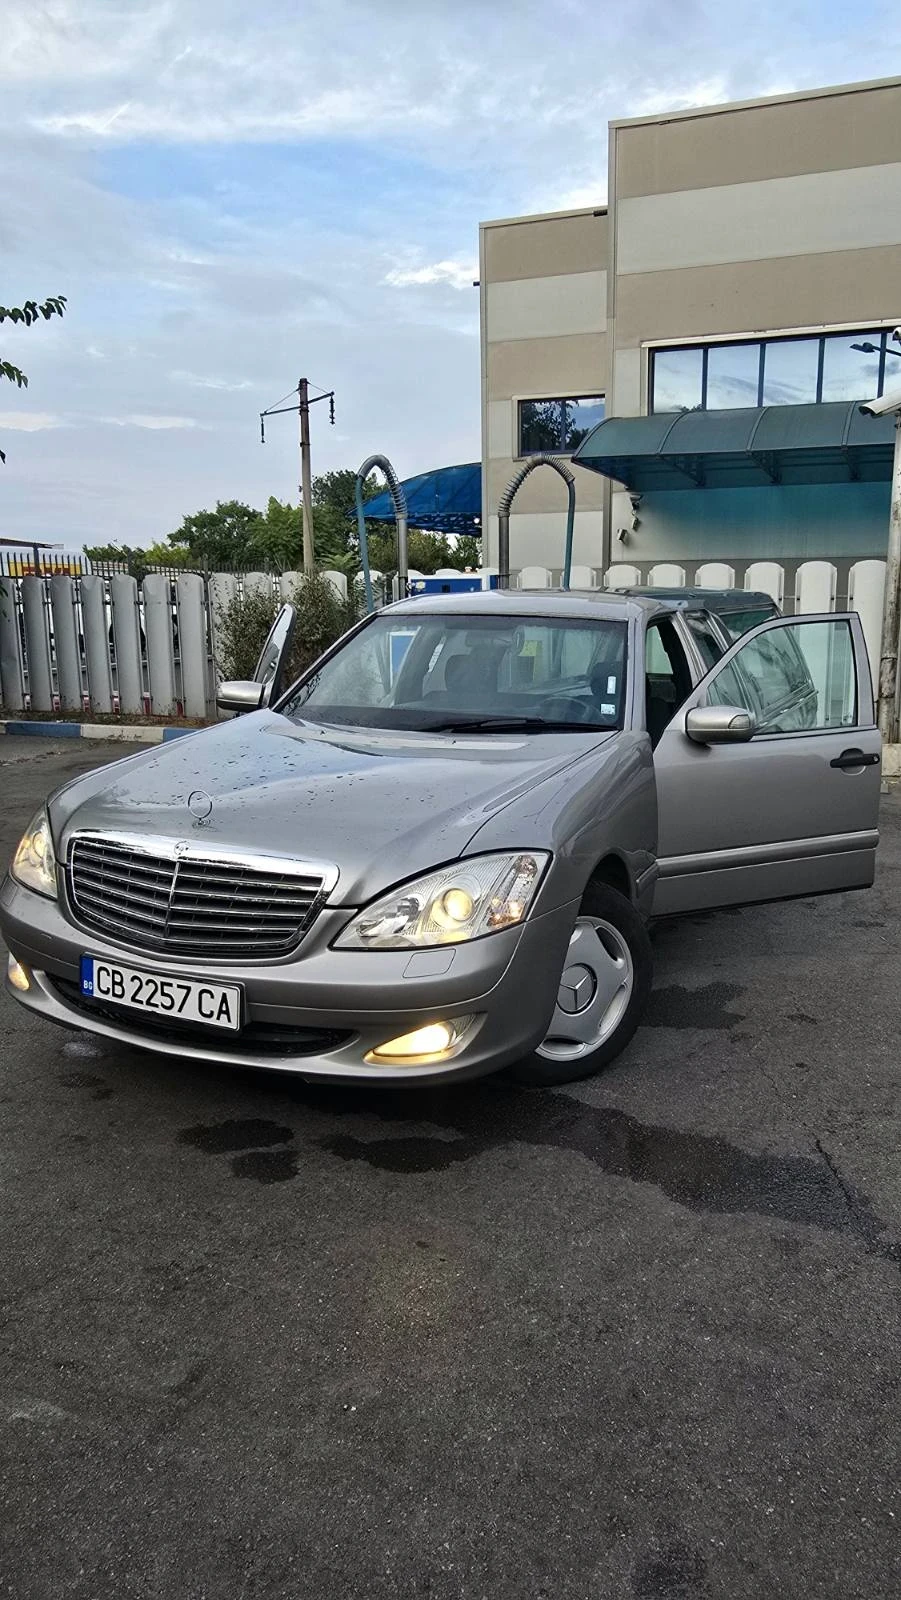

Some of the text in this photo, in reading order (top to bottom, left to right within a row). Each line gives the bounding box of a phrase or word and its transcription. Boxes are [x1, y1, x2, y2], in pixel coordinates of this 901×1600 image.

[83, 980, 93, 990] BG
[97, 966, 232, 1023] CB 2257 CA
